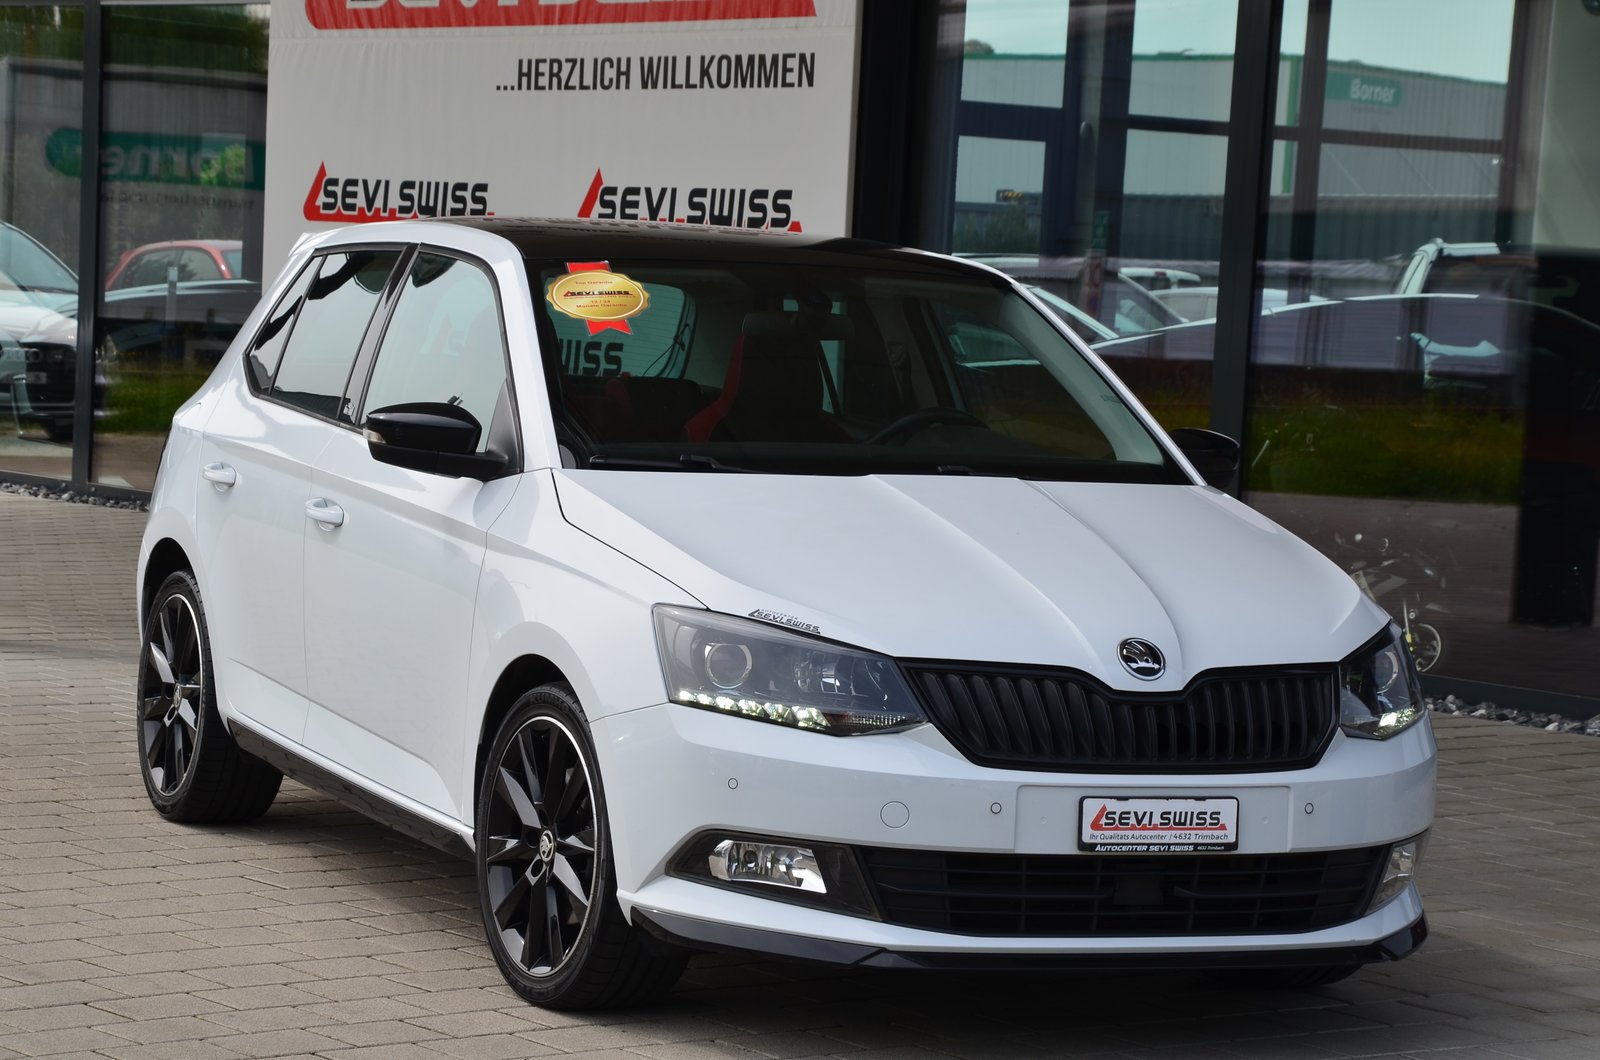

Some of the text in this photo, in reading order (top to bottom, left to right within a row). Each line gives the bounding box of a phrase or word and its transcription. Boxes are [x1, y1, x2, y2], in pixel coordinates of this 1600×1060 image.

[639, 52, 816, 90] WILLKOMMEN
[1350, 78, 1396, 103] Borner
[320, 177, 489, 217] SEVI SWISS
[598, 186, 794, 229] SEVI SWISS
[756, 611, 820, 632] SEVI SWISS
[1103, 810, 1221, 827] SEVI SWISS
[1131, 833, 1167, 841] Autocenter
[1194, 833, 1229, 841] Trimbach
